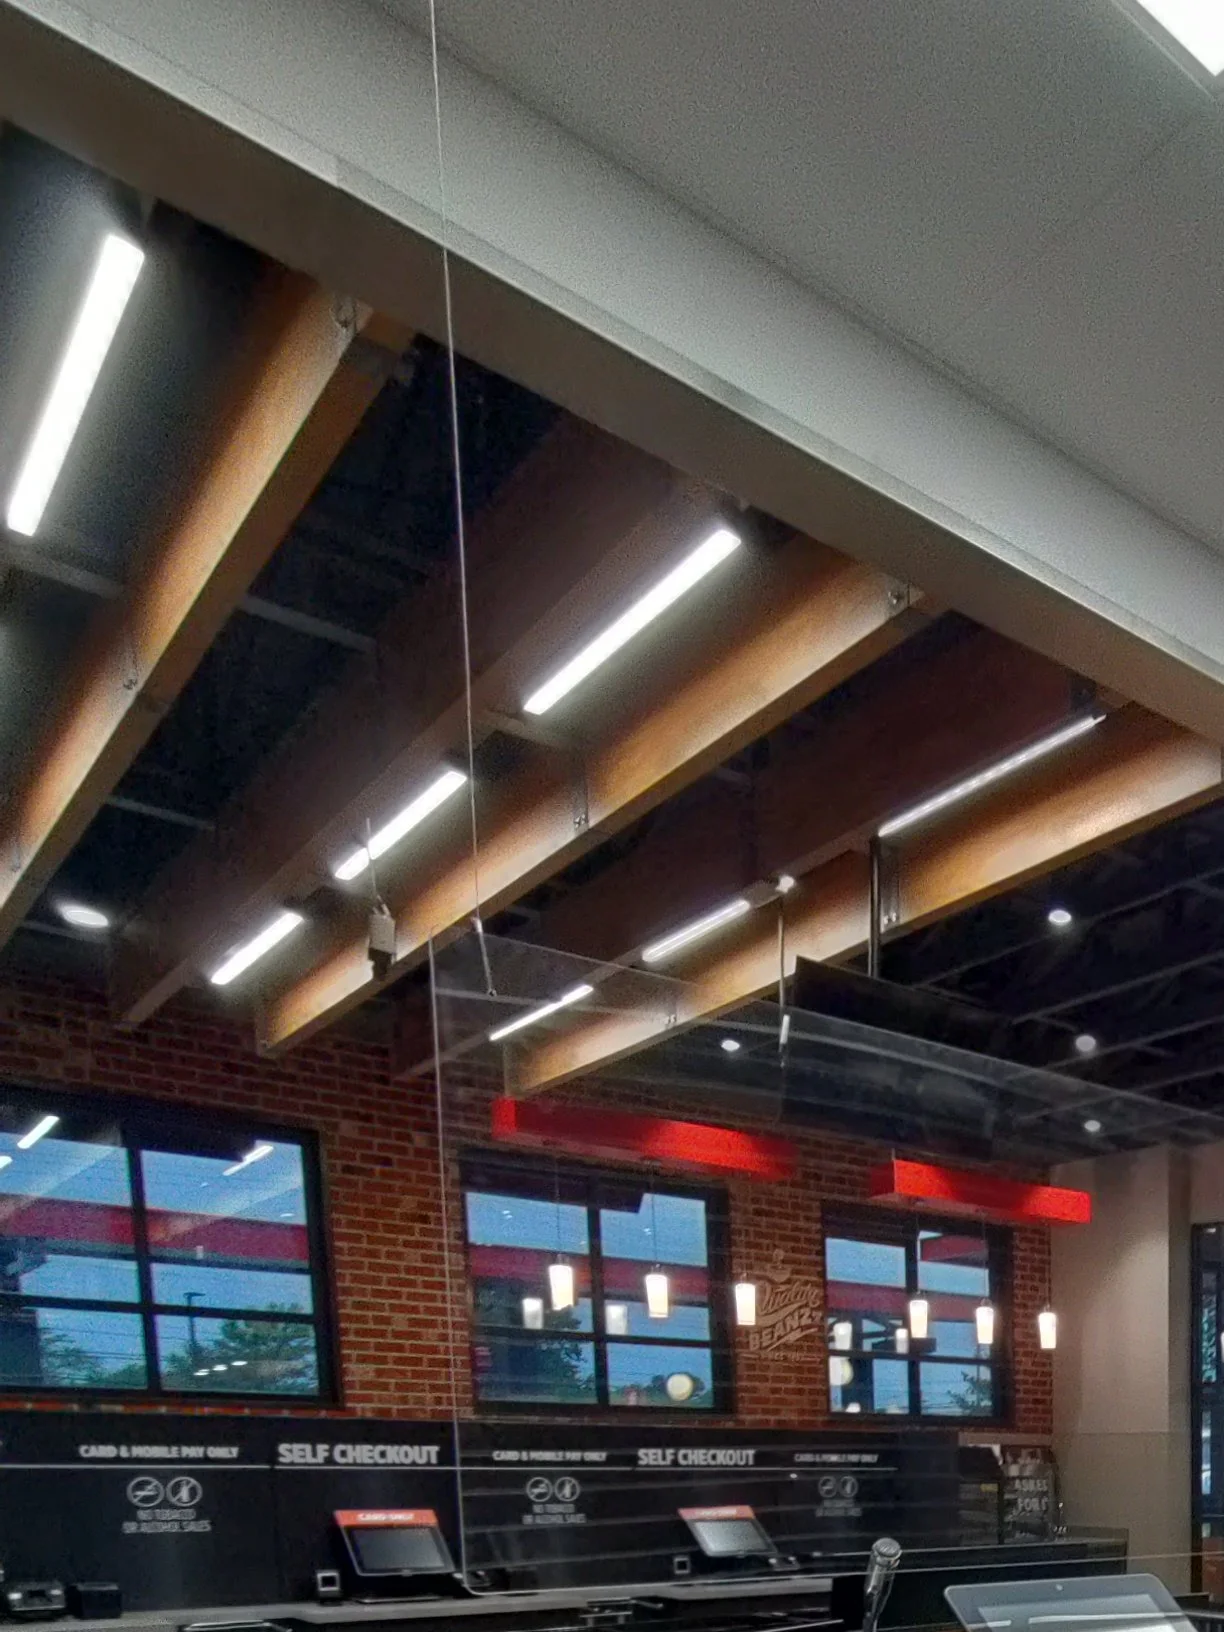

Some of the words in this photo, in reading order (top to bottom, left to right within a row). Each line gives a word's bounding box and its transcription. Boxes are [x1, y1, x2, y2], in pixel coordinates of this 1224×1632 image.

[79, 1445, 117, 1458] CARD
[278, 1443, 330, 1464] SELF
[333, 1444, 440, 1465] CHECKOUT
[492, 1451, 520, 1461] CARD
[637, 1448, 676, 1465] SELF
[677, 1449, 756, 1466] CHECKOUT
